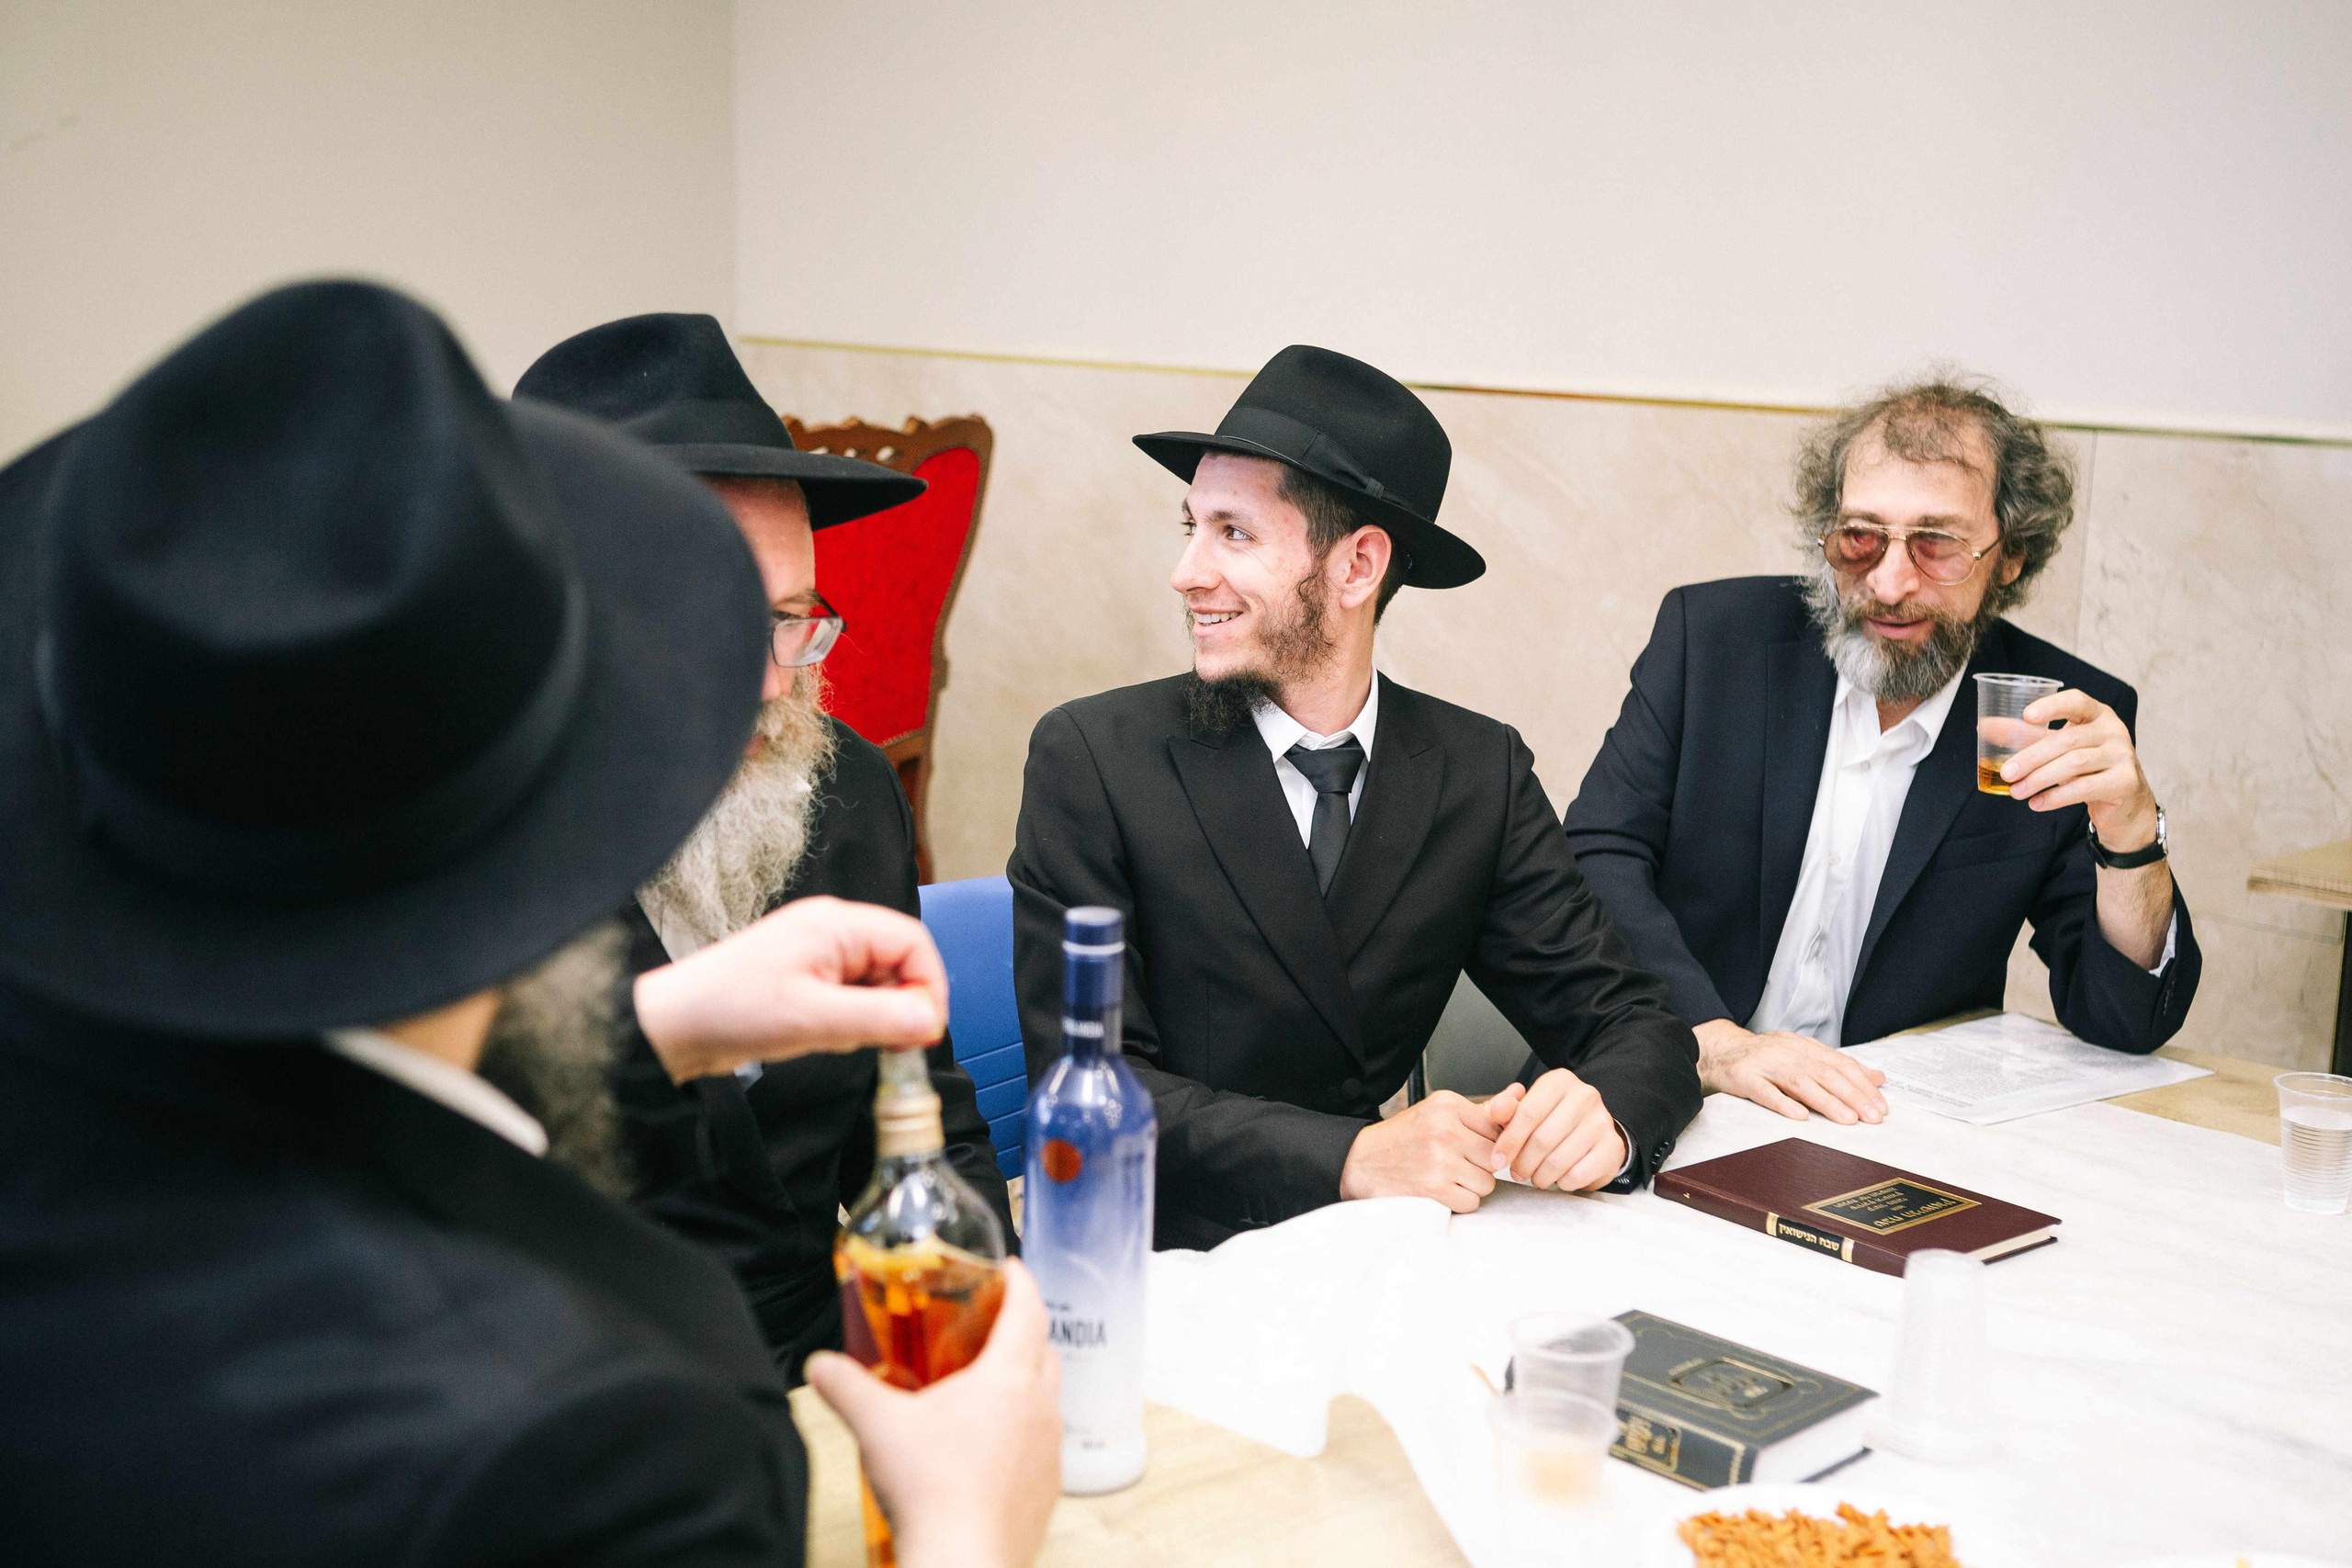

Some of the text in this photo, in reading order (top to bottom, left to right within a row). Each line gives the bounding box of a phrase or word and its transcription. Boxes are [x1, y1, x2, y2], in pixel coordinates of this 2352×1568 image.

[1778, 1224, 1839, 1251] שבח הנישואין
[1047, 1317, 1106, 1347] ANDIA
